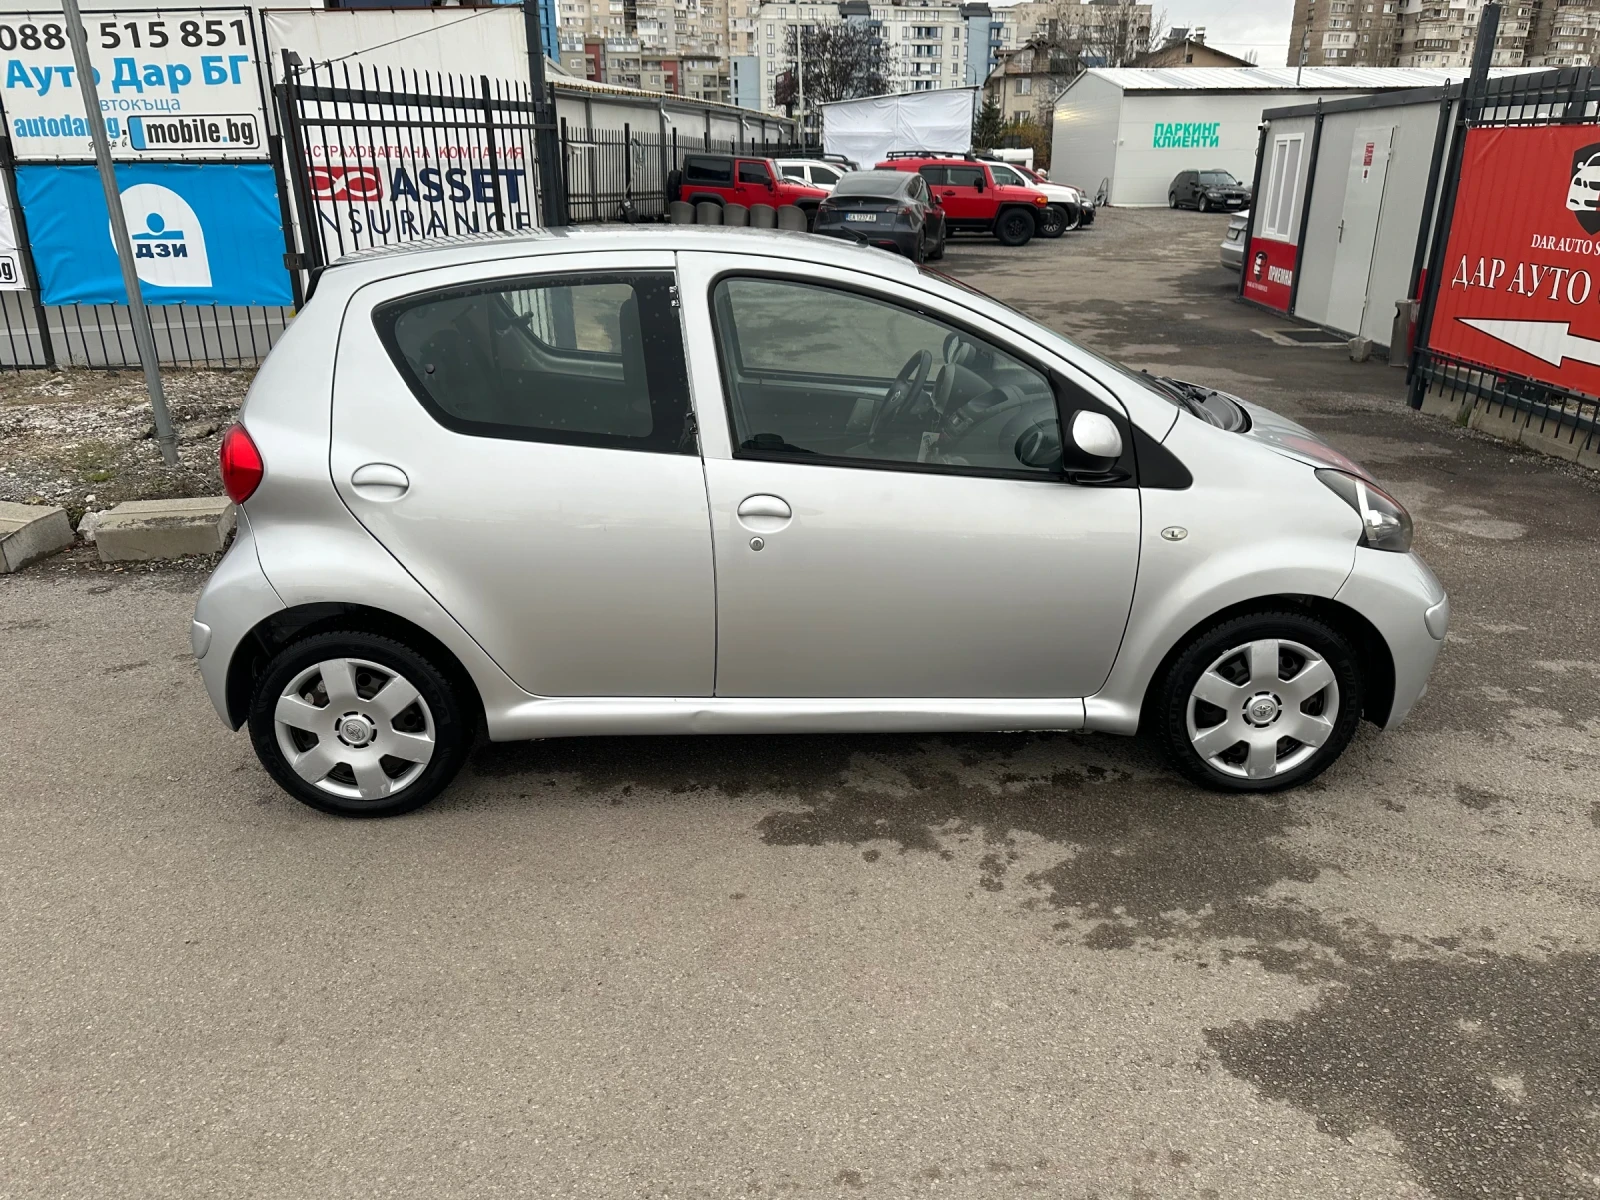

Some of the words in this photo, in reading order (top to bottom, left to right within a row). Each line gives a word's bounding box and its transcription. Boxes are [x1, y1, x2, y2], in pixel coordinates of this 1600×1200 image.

[0, 23, 88, 51] 088
[100, 21, 169, 49] 515
[180, 19, 247, 48] 851
[111, 57, 192, 94] Дар
[200, 55, 249, 85] БГ
[99, 98, 181, 113] втокъща
[146, 118, 254, 145] mobile.bg
[1153, 135, 1219, 148] КЛИЕНТИ
[1154, 122, 1220, 136] ПАРКИНГ
[390, 167, 525, 204] ASSET
[1531, 234, 1556, 250] DAR
[1556, 237, 1593, 255] AUTO
[1452, 254, 1505, 291] ДАР
[1507, 262, 1592, 306] АУТО
